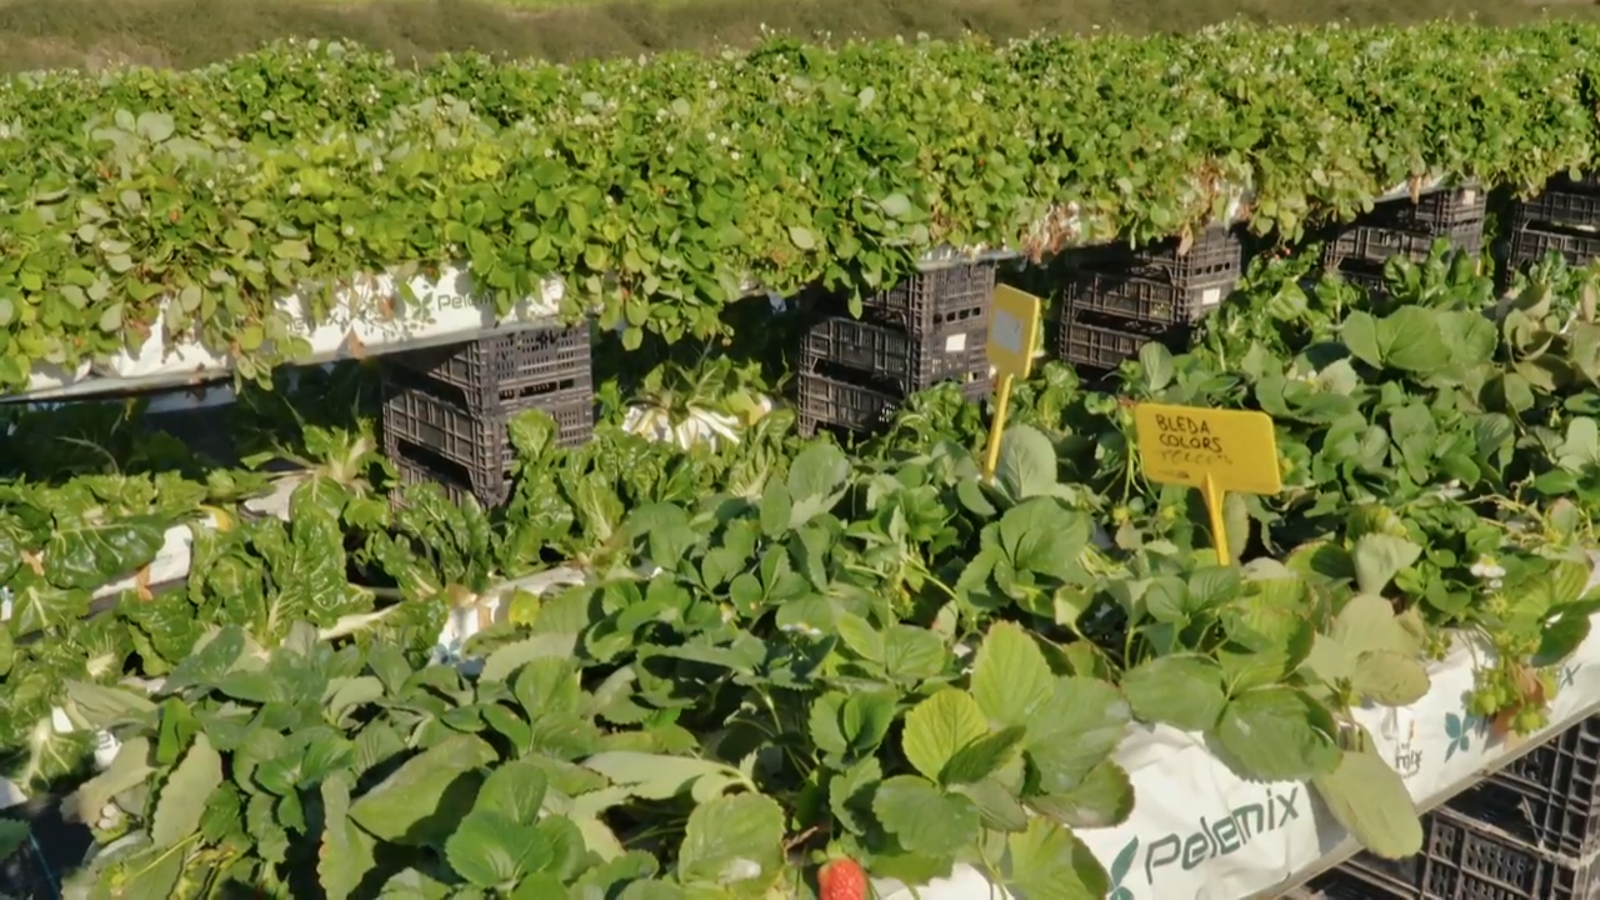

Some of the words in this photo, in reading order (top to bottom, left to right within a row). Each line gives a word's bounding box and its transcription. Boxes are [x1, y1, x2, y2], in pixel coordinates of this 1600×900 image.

[1155, 414, 1211, 434] BLEDA
[1158, 433, 1223, 453] COLORS
[1144, 786, 1299, 885] Pelemix
